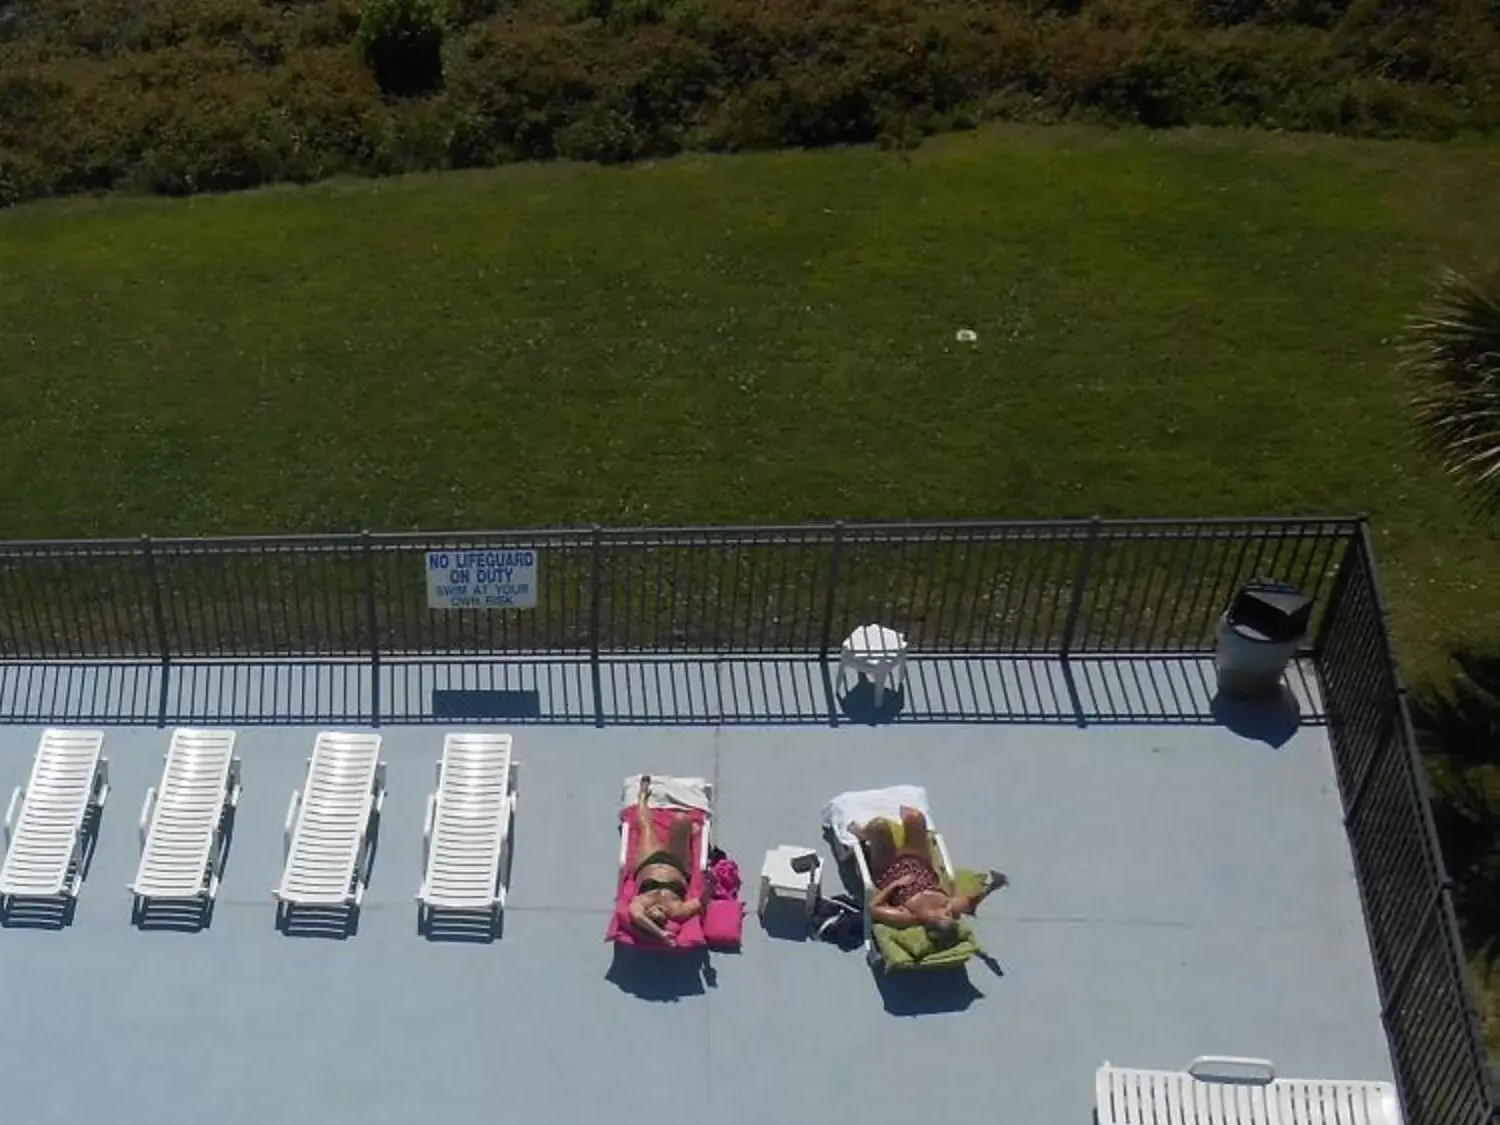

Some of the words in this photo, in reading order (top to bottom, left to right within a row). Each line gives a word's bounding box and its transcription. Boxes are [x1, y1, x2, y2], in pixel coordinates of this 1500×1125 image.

[429, 554, 449, 569] NO
[456, 551, 533, 568] LIFEGUARD
[450, 569, 470, 584] ON
[477, 567, 513, 583] DUTY
[436, 585, 467, 597] SWIM
[474, 584, 488, 595] AT
[495, 583, 529, 595] YOUR
[451, 597, 480, 607] OWN
[485, 595, 514, 605] RISK
